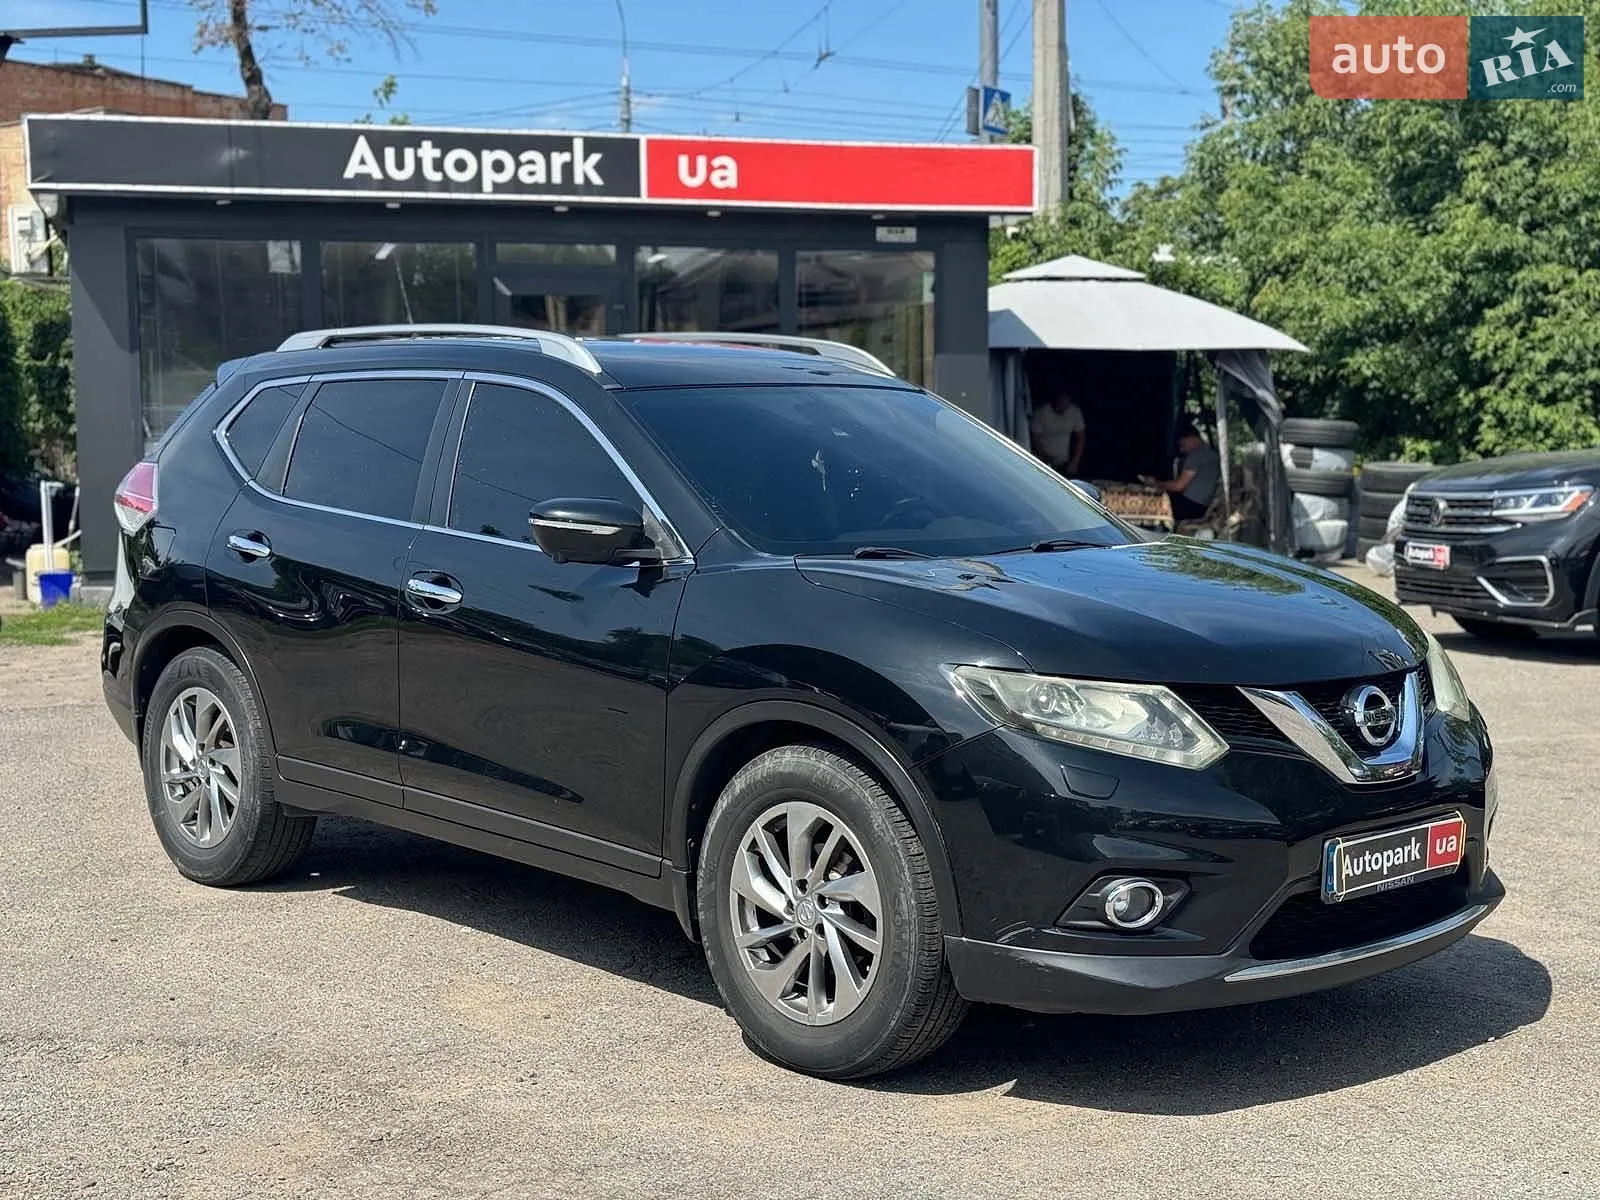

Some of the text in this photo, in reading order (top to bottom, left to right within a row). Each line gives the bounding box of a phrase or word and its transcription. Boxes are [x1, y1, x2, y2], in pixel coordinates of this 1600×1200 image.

[343, 135, 738, 192] Autopark ua
[1342, 834, 1457, 877] Autopark ua
[1376, 876, 1415, 892] NISSAN
